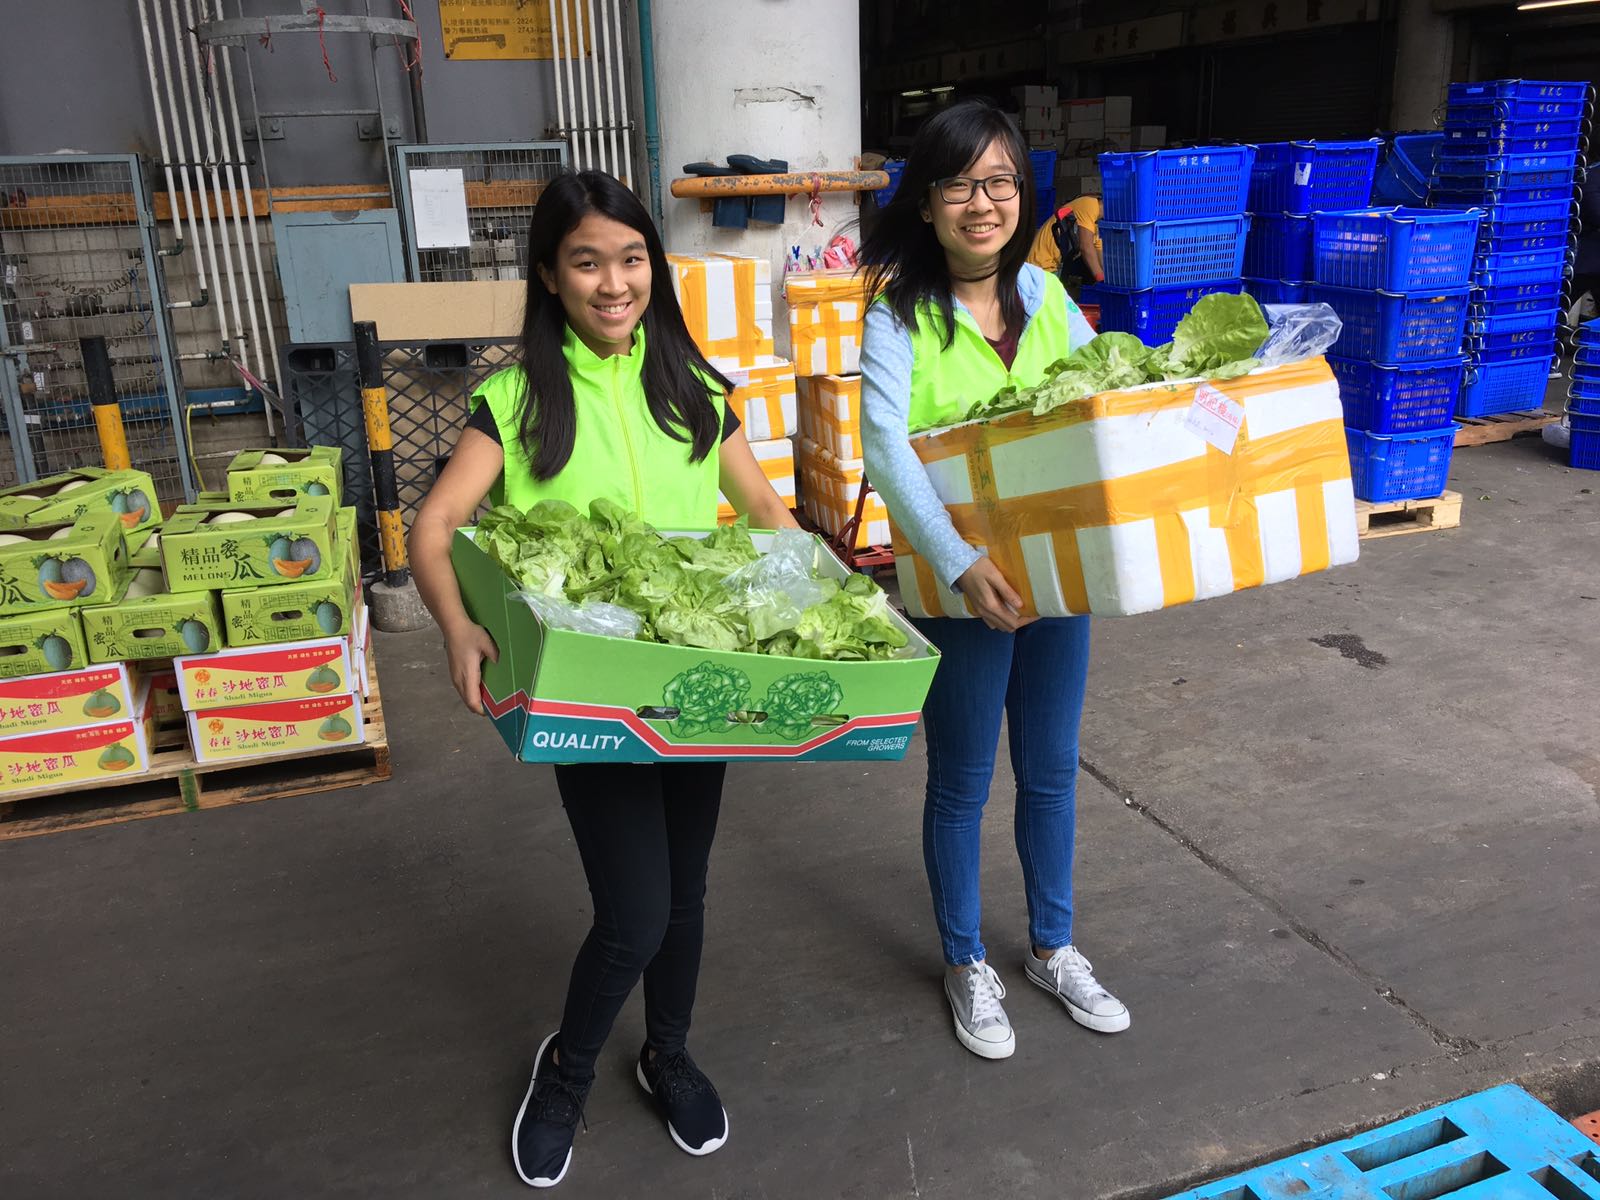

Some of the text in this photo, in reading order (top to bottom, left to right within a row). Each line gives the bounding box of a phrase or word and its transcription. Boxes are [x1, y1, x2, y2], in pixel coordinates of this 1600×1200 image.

[1539, 86, 1563, 97] MKC
[1524, 221, 1547, 232] MKC
[1523, 237, 1545, 248] MKC
[1519, 284, 1540, 295] MKC
[1515, 300, 1537, 311] MKC
[1511, 331, 1535, 343] MKC
[1333, 360, 1358, 375] MKC
[180, 547, 220, 566] 精品
[183, 570, 231, 581] MELONS
[249, 691, 273, 699] Migua
[20, 718, 47, 727] Migua
[261, 740, 286, 748] Migua
[531, 730, 627, 752] QUALITY
[845, 735, 909, 747] FROM SELECTED
[866, 742, 907, 752] GROWERS
[37, 771, 64, 780] Migua
